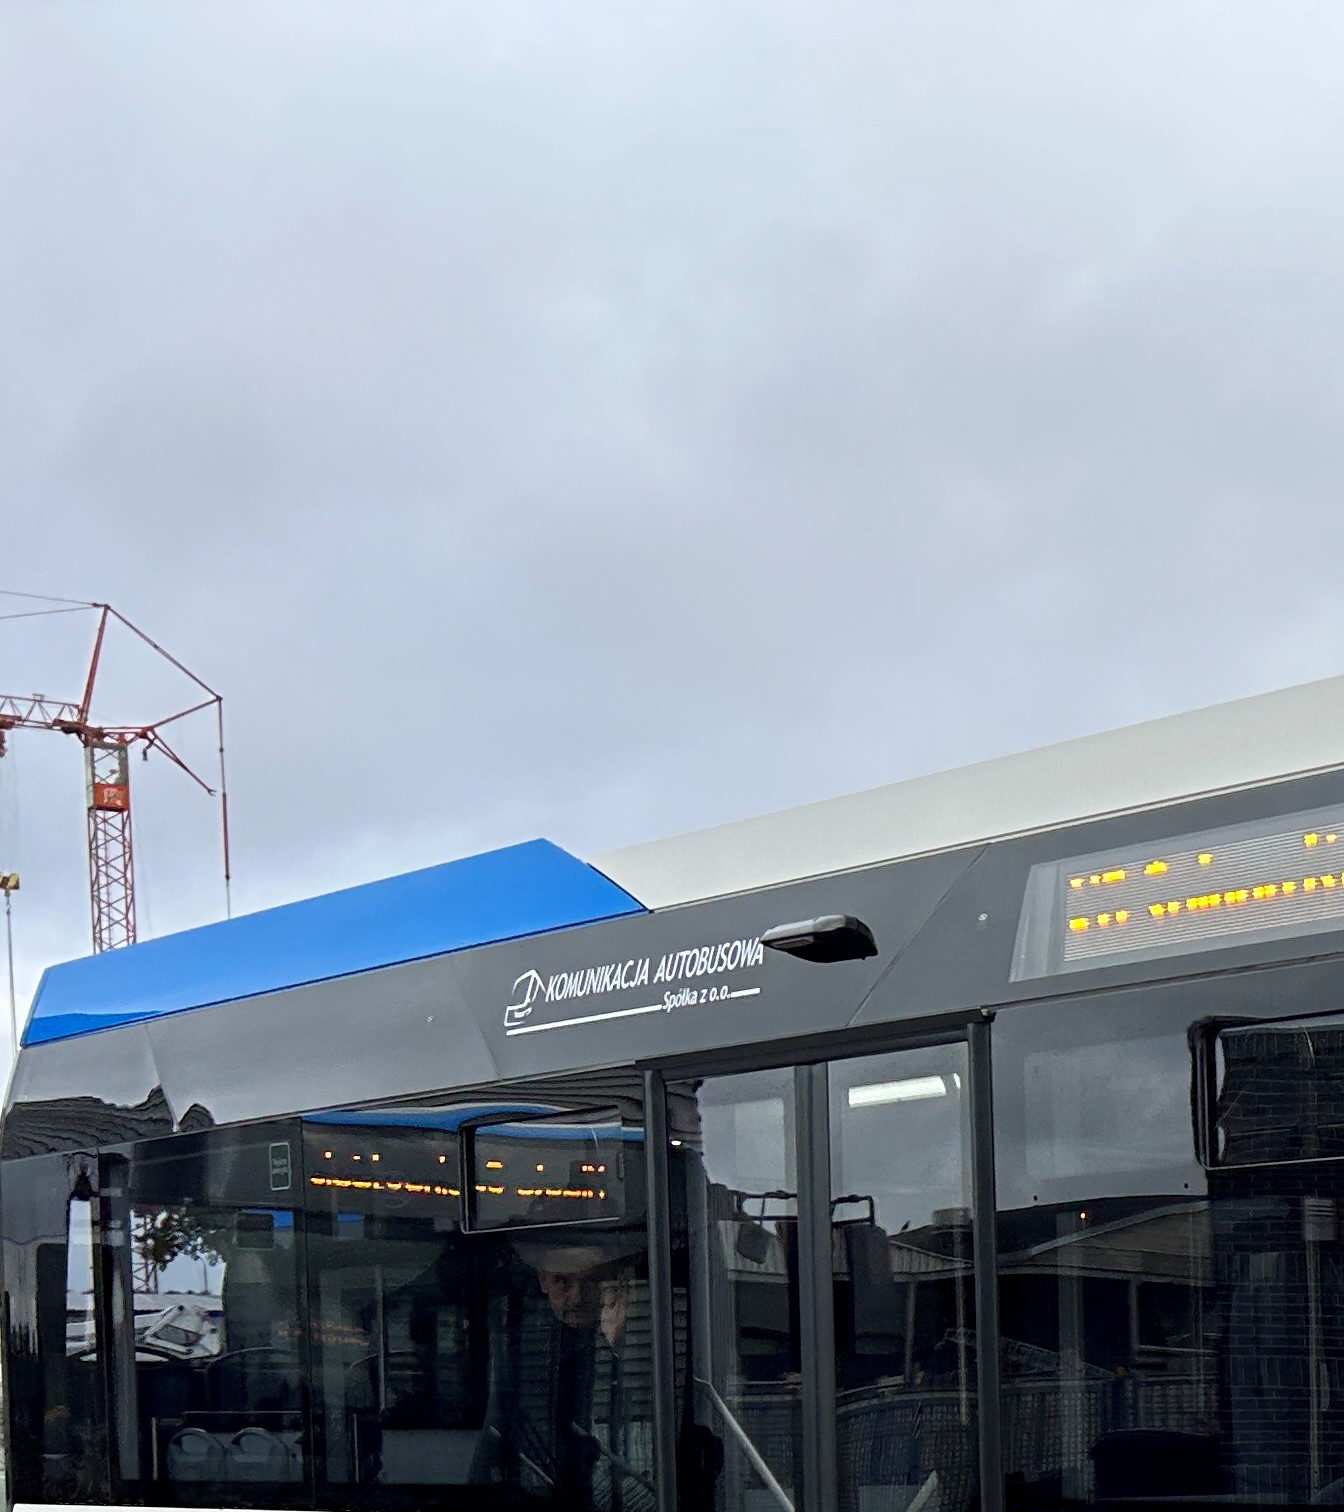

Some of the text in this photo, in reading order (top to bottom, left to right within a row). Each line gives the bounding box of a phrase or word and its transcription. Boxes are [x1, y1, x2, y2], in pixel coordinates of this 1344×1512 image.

[545, 936, 764, 1003] KOMUNIKACJA AUTOBUSOWA
[662, 985, 732, 1014] Spółka z o.o.
